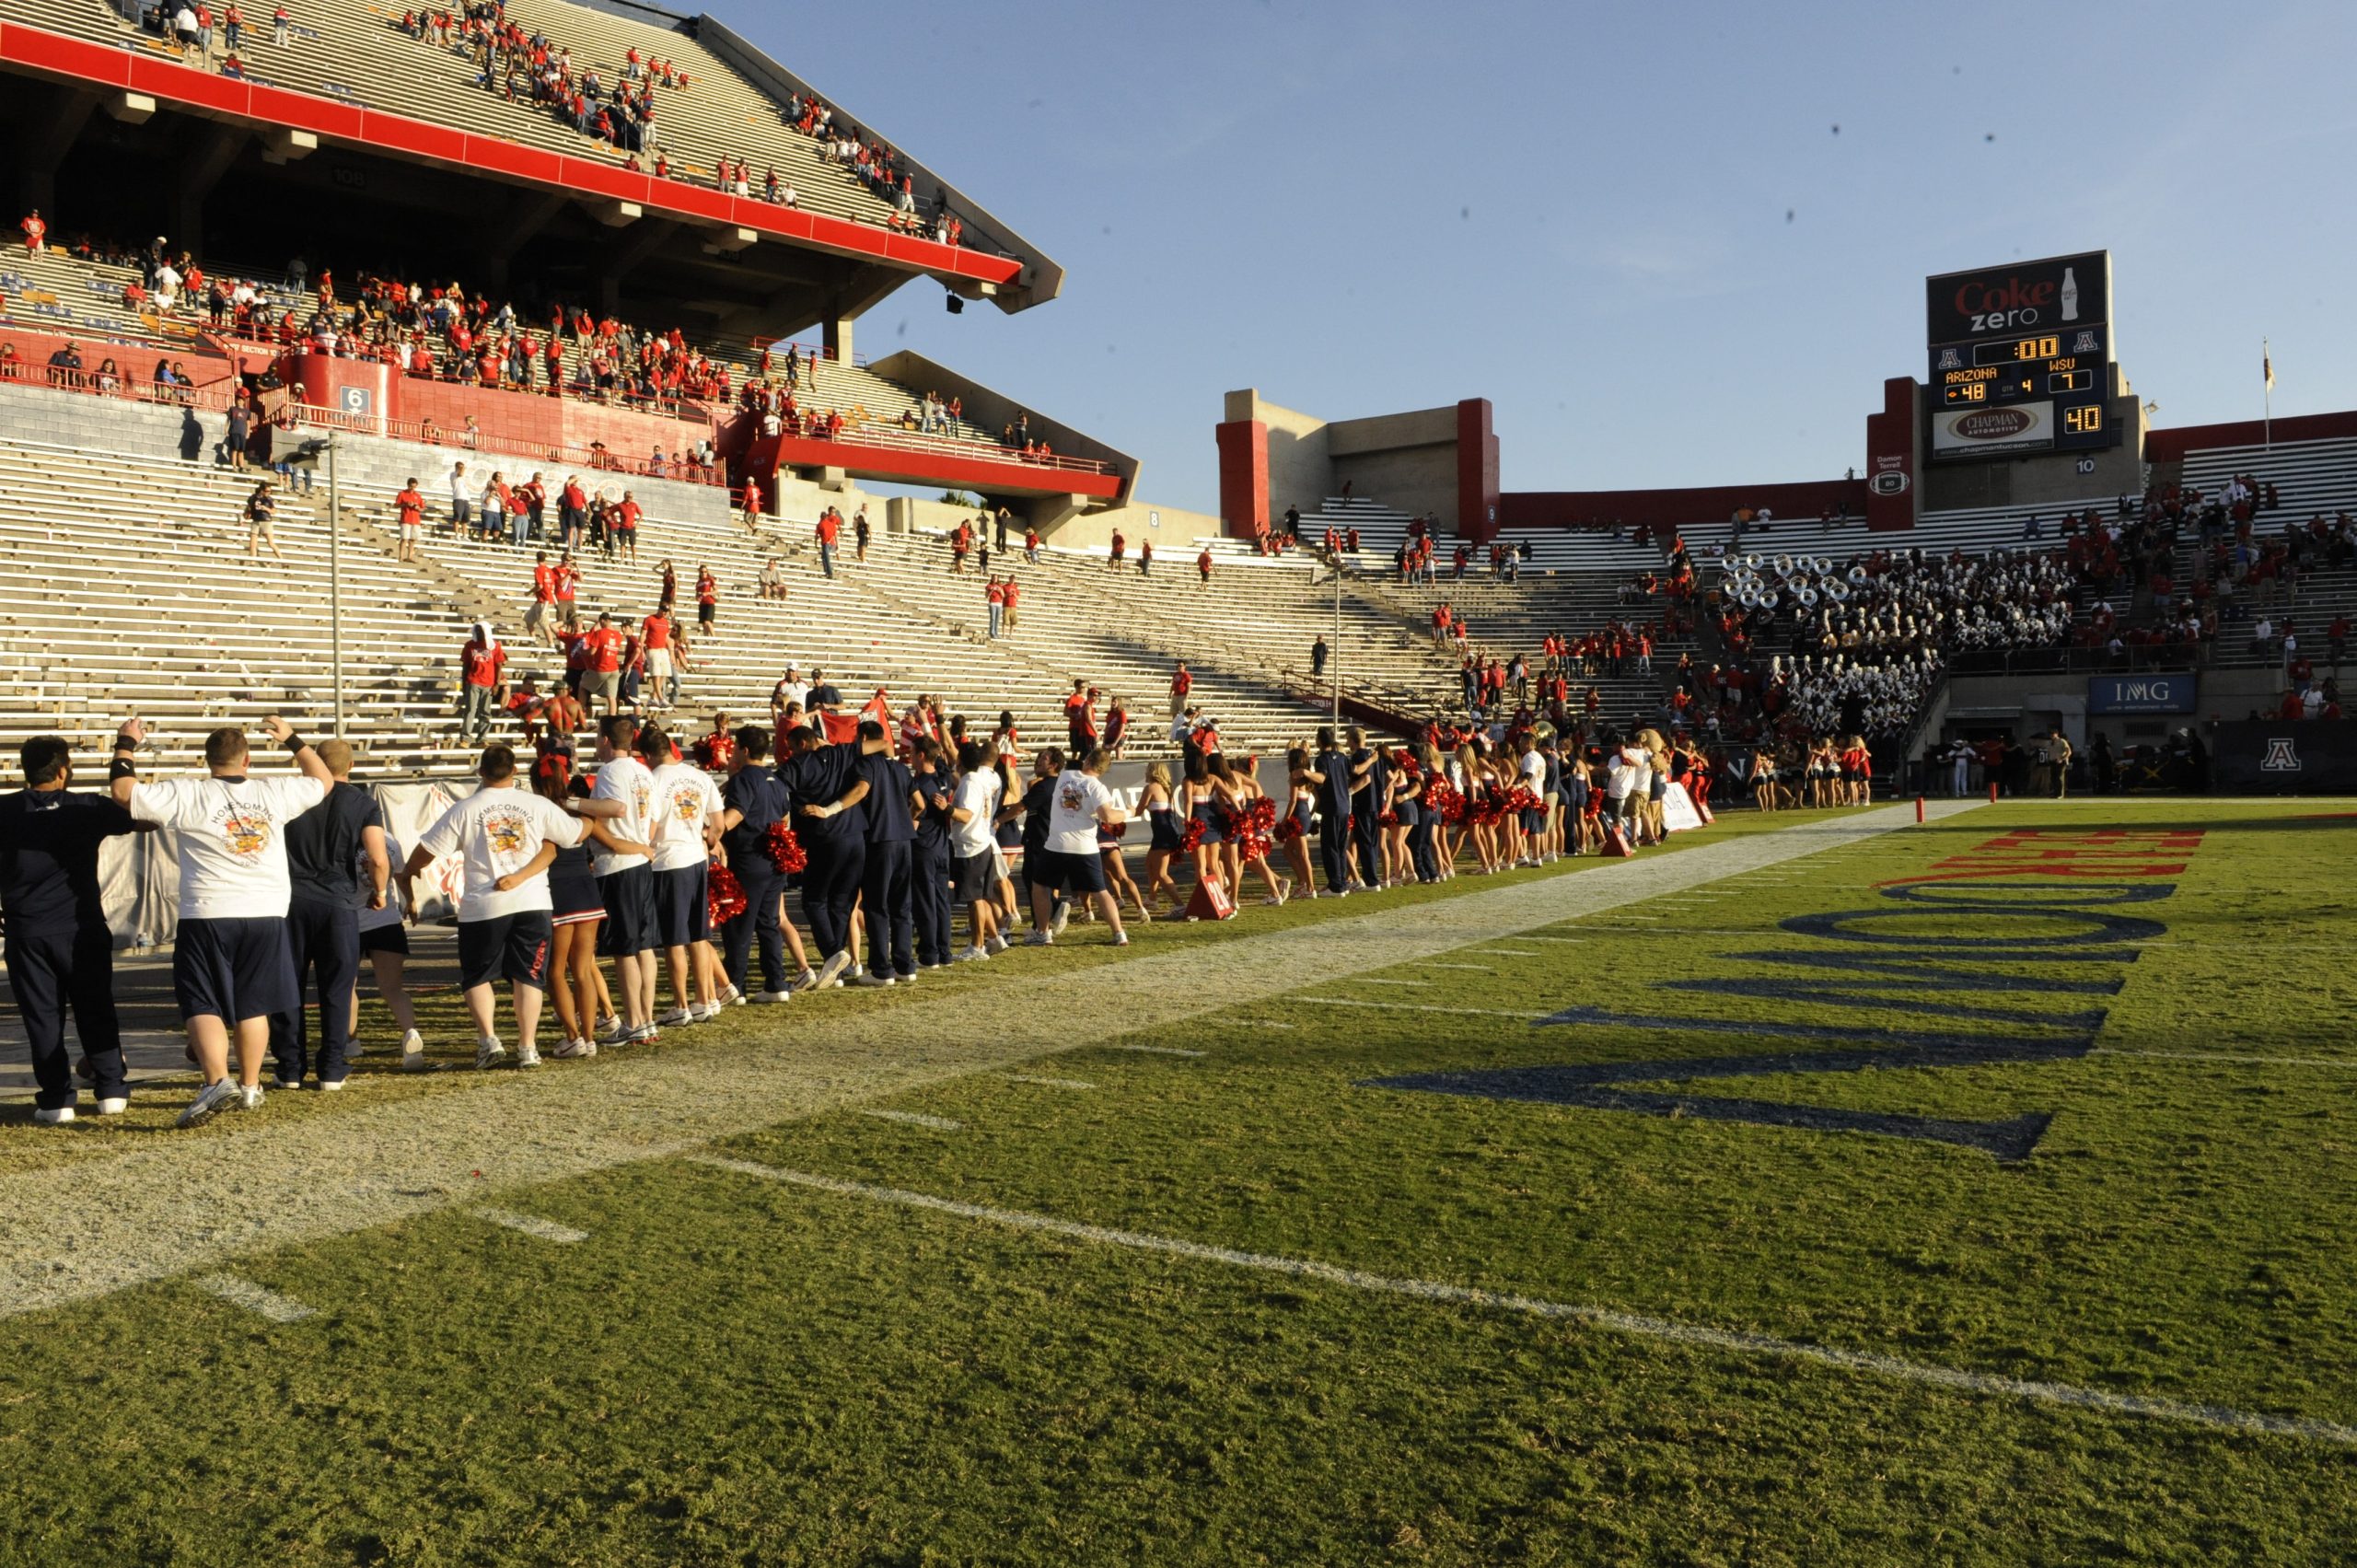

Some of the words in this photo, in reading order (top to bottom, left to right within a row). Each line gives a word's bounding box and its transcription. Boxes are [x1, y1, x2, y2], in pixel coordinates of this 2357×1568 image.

[1955, 277, 2055, 316] Coke
[1970, 308, 2038, 331] zero
[241, 344, 269, 355] SECTION
[2049, 358, 2074, 371] WSU
[1945, 367, 1997, 384] ARIZONA
[2061, 373, 2073, 389] 7
[1962, 383, 1984, 401] 48
[2021, 378, 2031, 392] 4
[347, 389, 363, 407] 6
[1967, 413, 2019, 429] CHAPMAN
[2067, 407, 2099, 431] 40
[1968, 425, 2019, 436] AUTOMOTIVE
[2077, 460, 2095, 472] 10
[1151, 513, 1158, 526] 8
[2115, 681, 2169, 702] IMG
[211, 801, 274, 824] HOMECOMING
[475, 804, 534, 827] HOMECOMING
